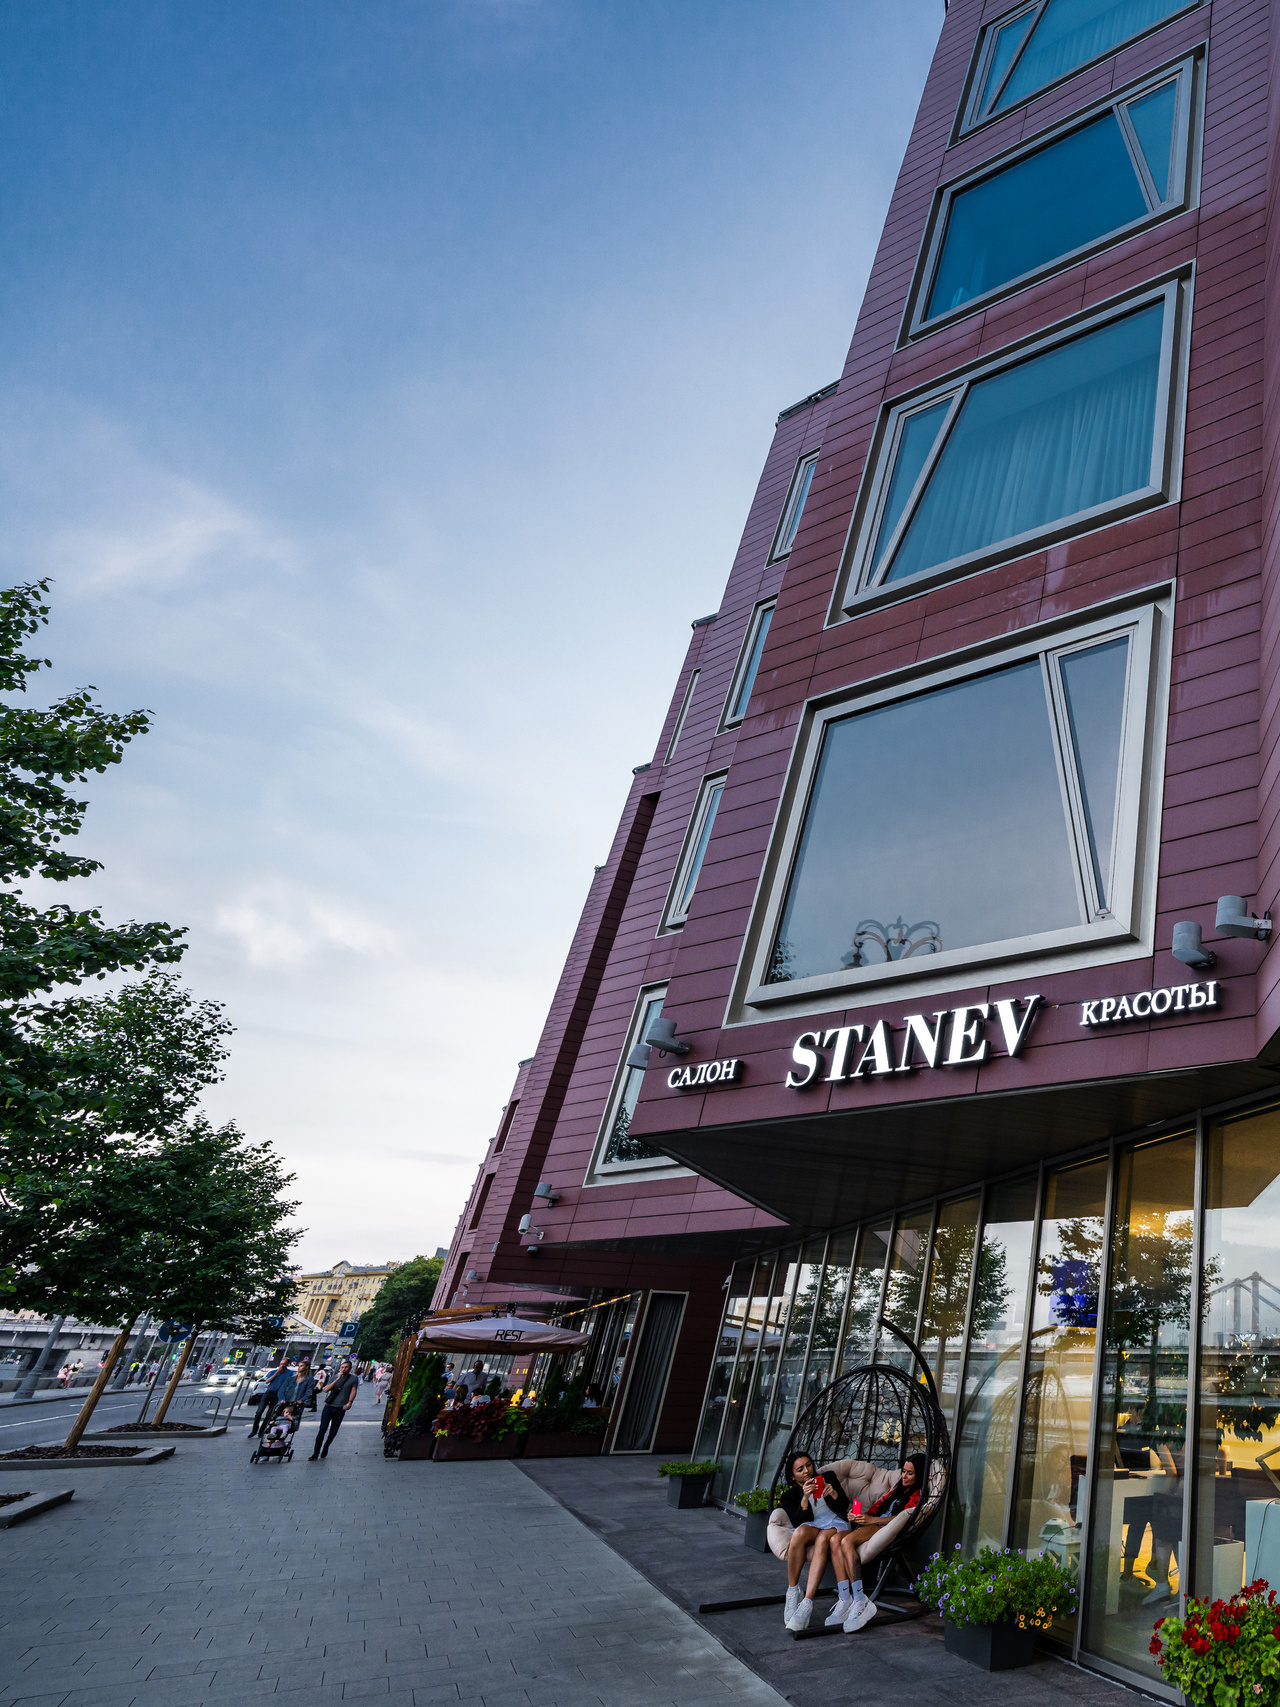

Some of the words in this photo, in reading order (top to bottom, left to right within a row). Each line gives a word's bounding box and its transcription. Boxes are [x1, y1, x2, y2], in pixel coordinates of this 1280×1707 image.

[667, 1059, 739, 1088] САЛОН
[785, 994, 1042, 1088] STANEV
[1079, 980, 1218, 1026] КРАСОТЫ
[494, 1329, 526, 1342] REST
